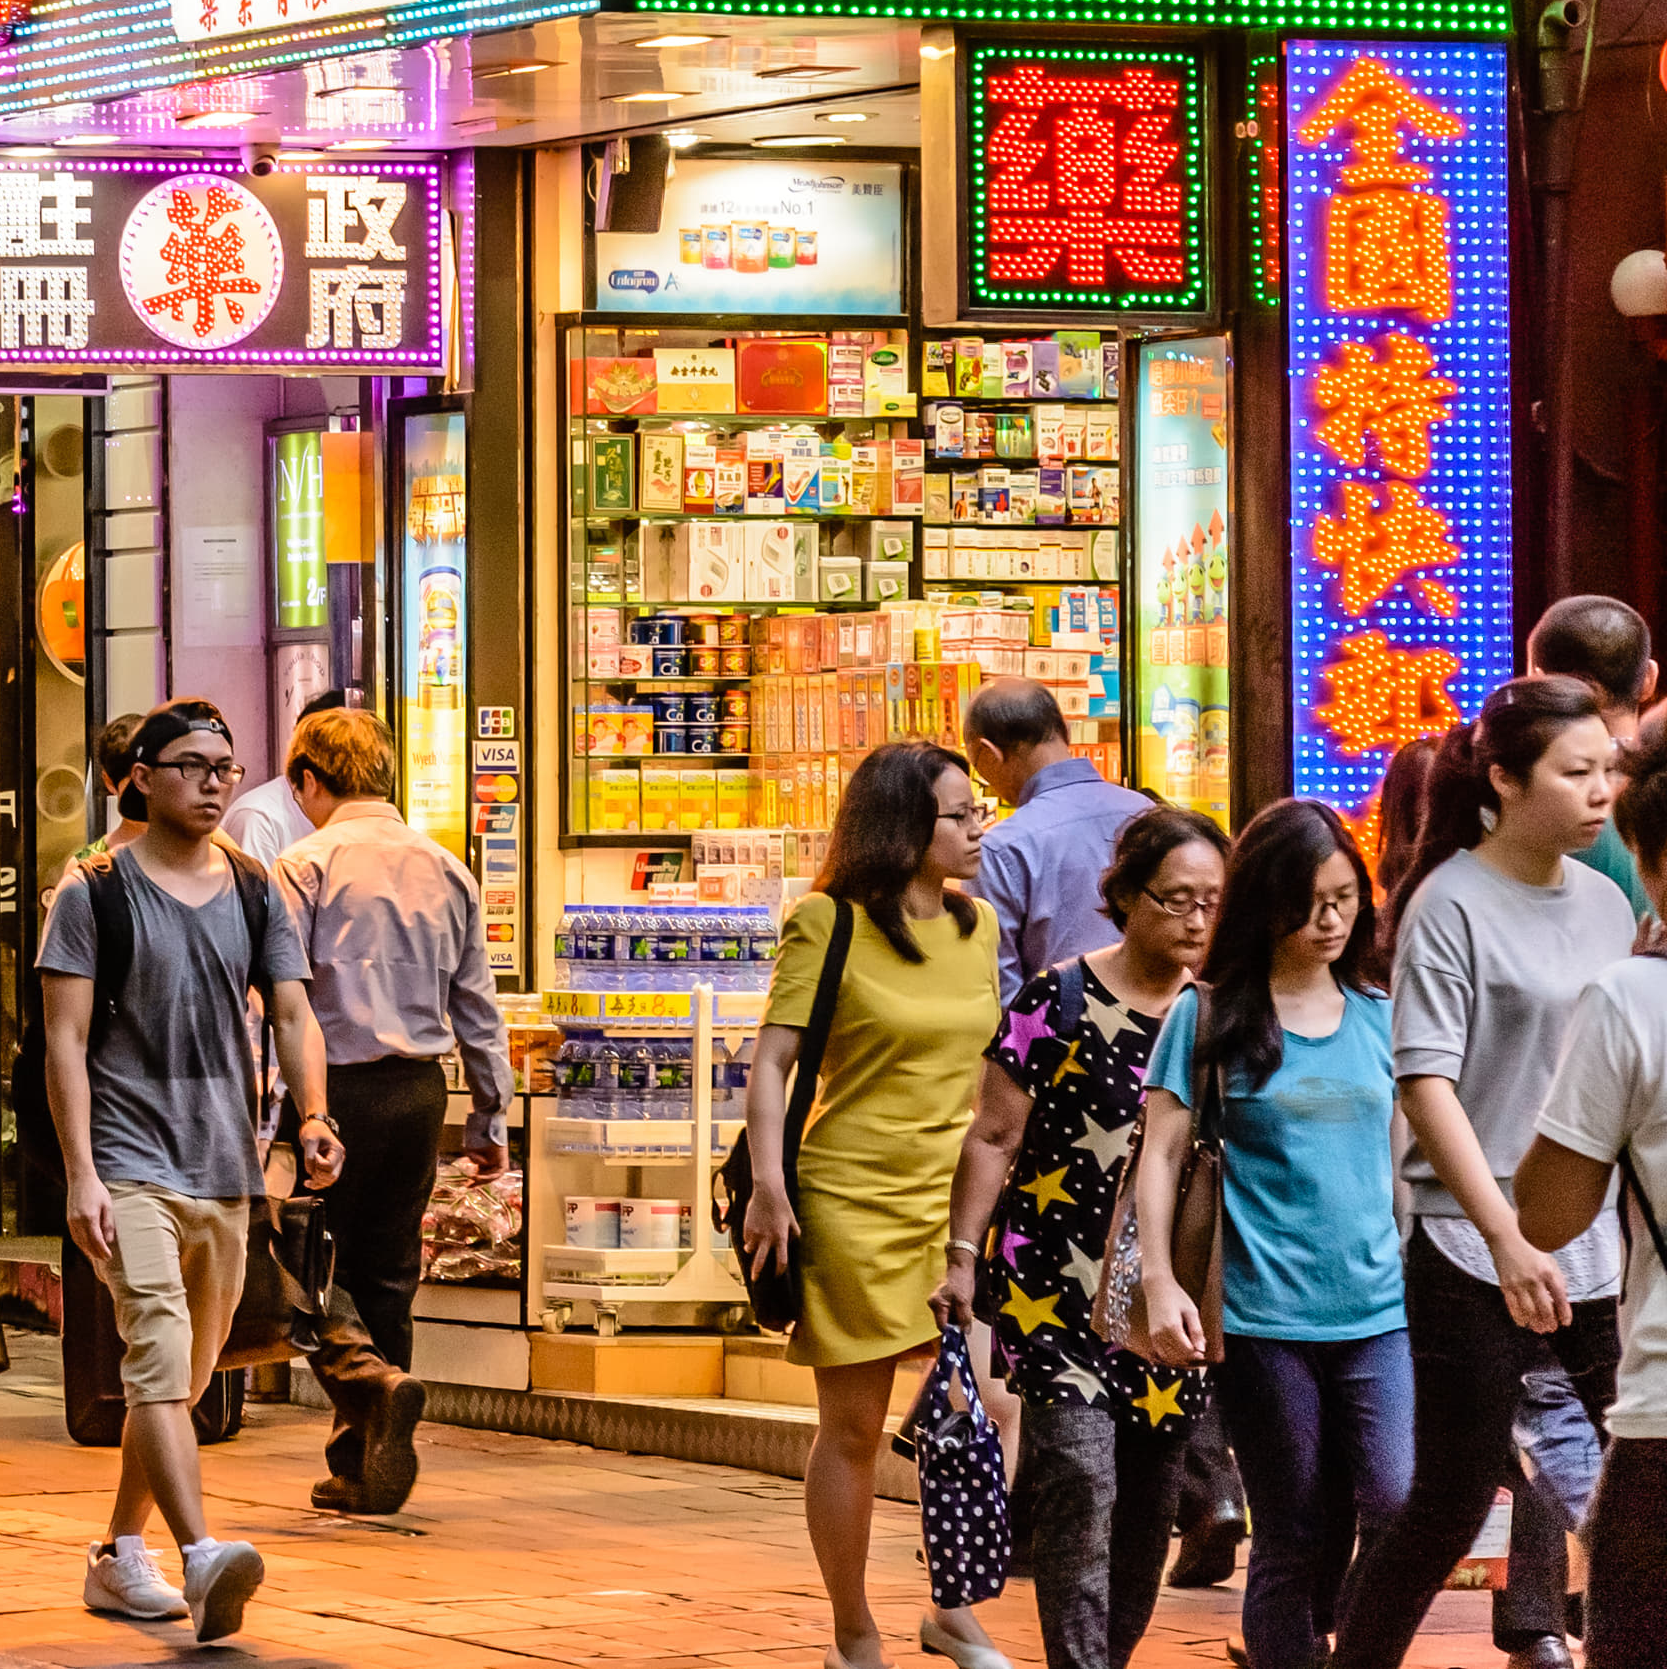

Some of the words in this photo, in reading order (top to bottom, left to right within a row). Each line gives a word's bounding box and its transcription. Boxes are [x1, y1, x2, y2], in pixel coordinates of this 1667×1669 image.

[987, 65, 1186, 285] 藥
[303, 173, 407, 350] 政府
[481, 749, 515, 761] VISA
[489, 952, 513, 964] VISA
